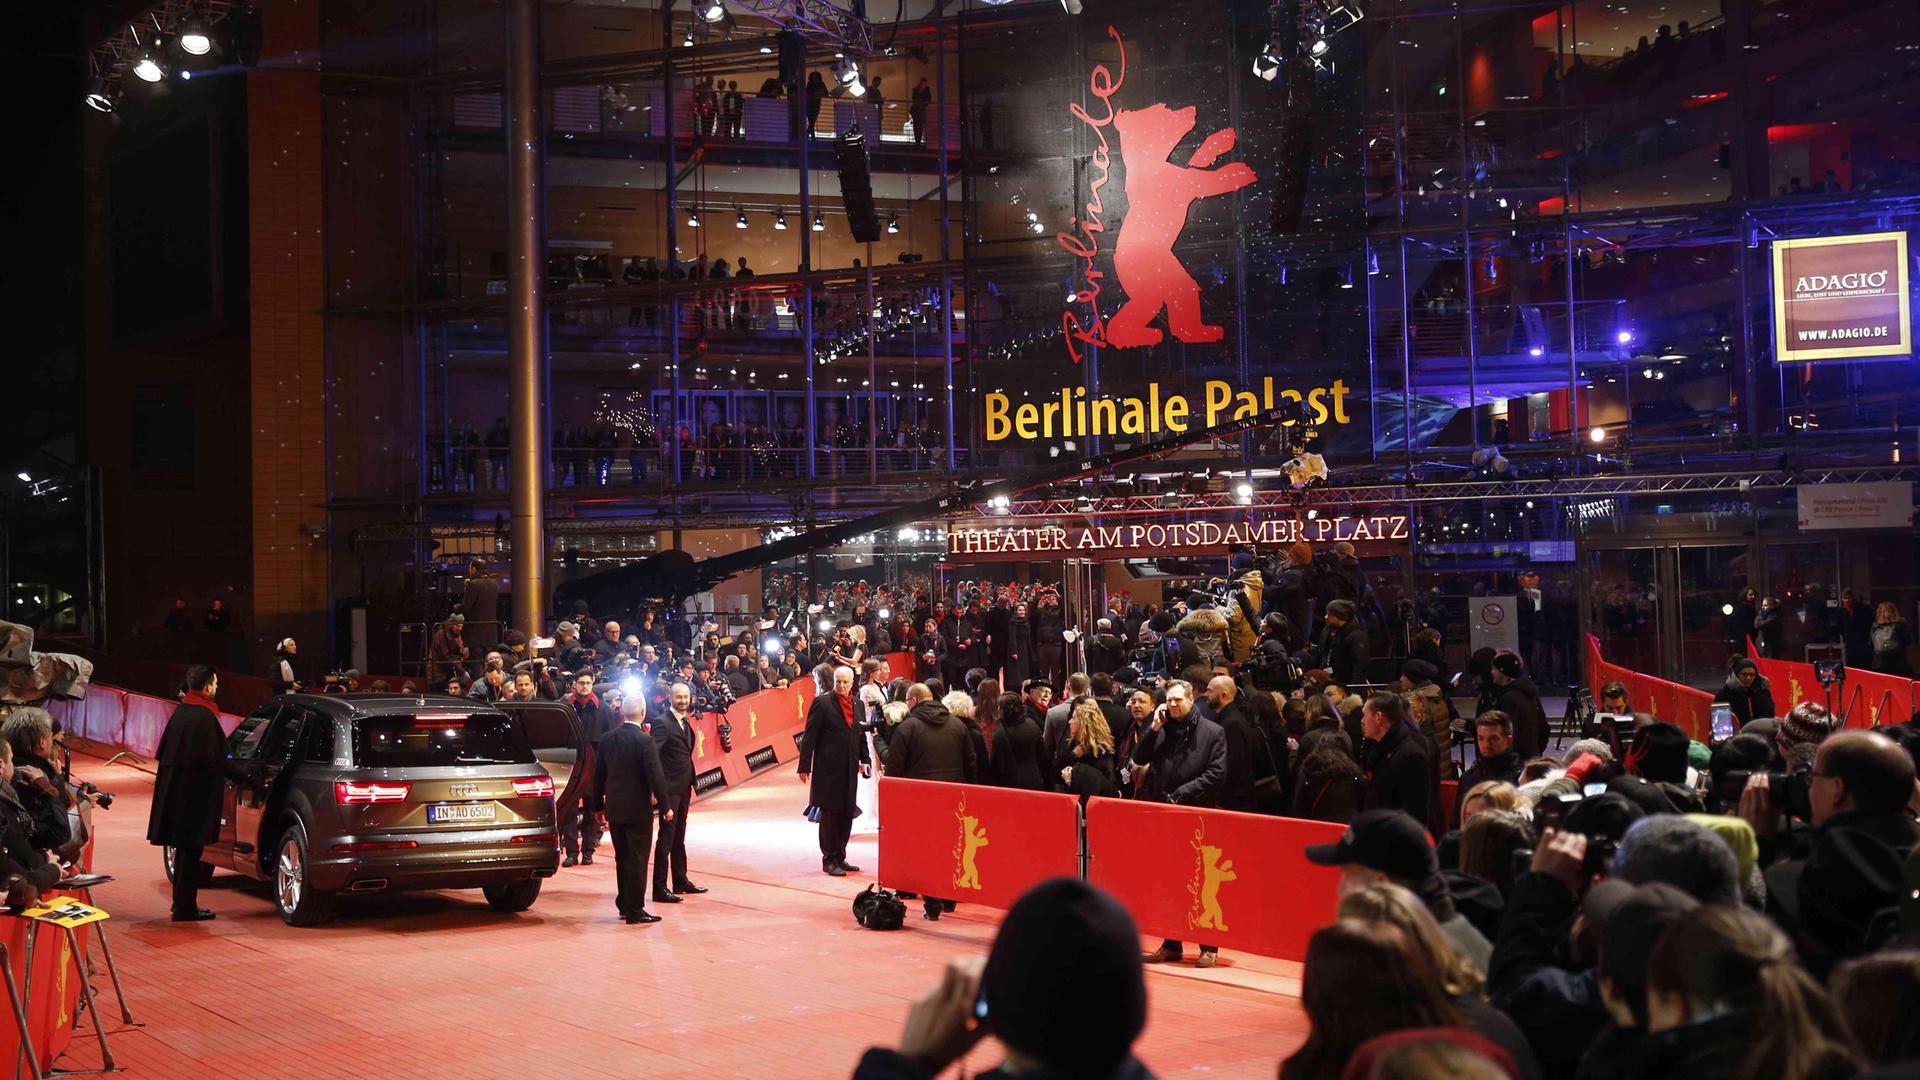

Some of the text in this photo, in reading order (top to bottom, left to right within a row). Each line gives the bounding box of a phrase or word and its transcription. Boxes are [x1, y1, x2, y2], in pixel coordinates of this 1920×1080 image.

[1057, 24, 1128, 364] Berlinale
[1795, 272, 1886, 292] ADAGIO
[1798, 326, 1888, 341] WWW.ADAGIO.DE
[985, 382, 1189, 441] Berlinale
[947, 516, 1409, 554] THEATER AM POTSDAMER PLATZ
[437, 808, 449, 819] IN
